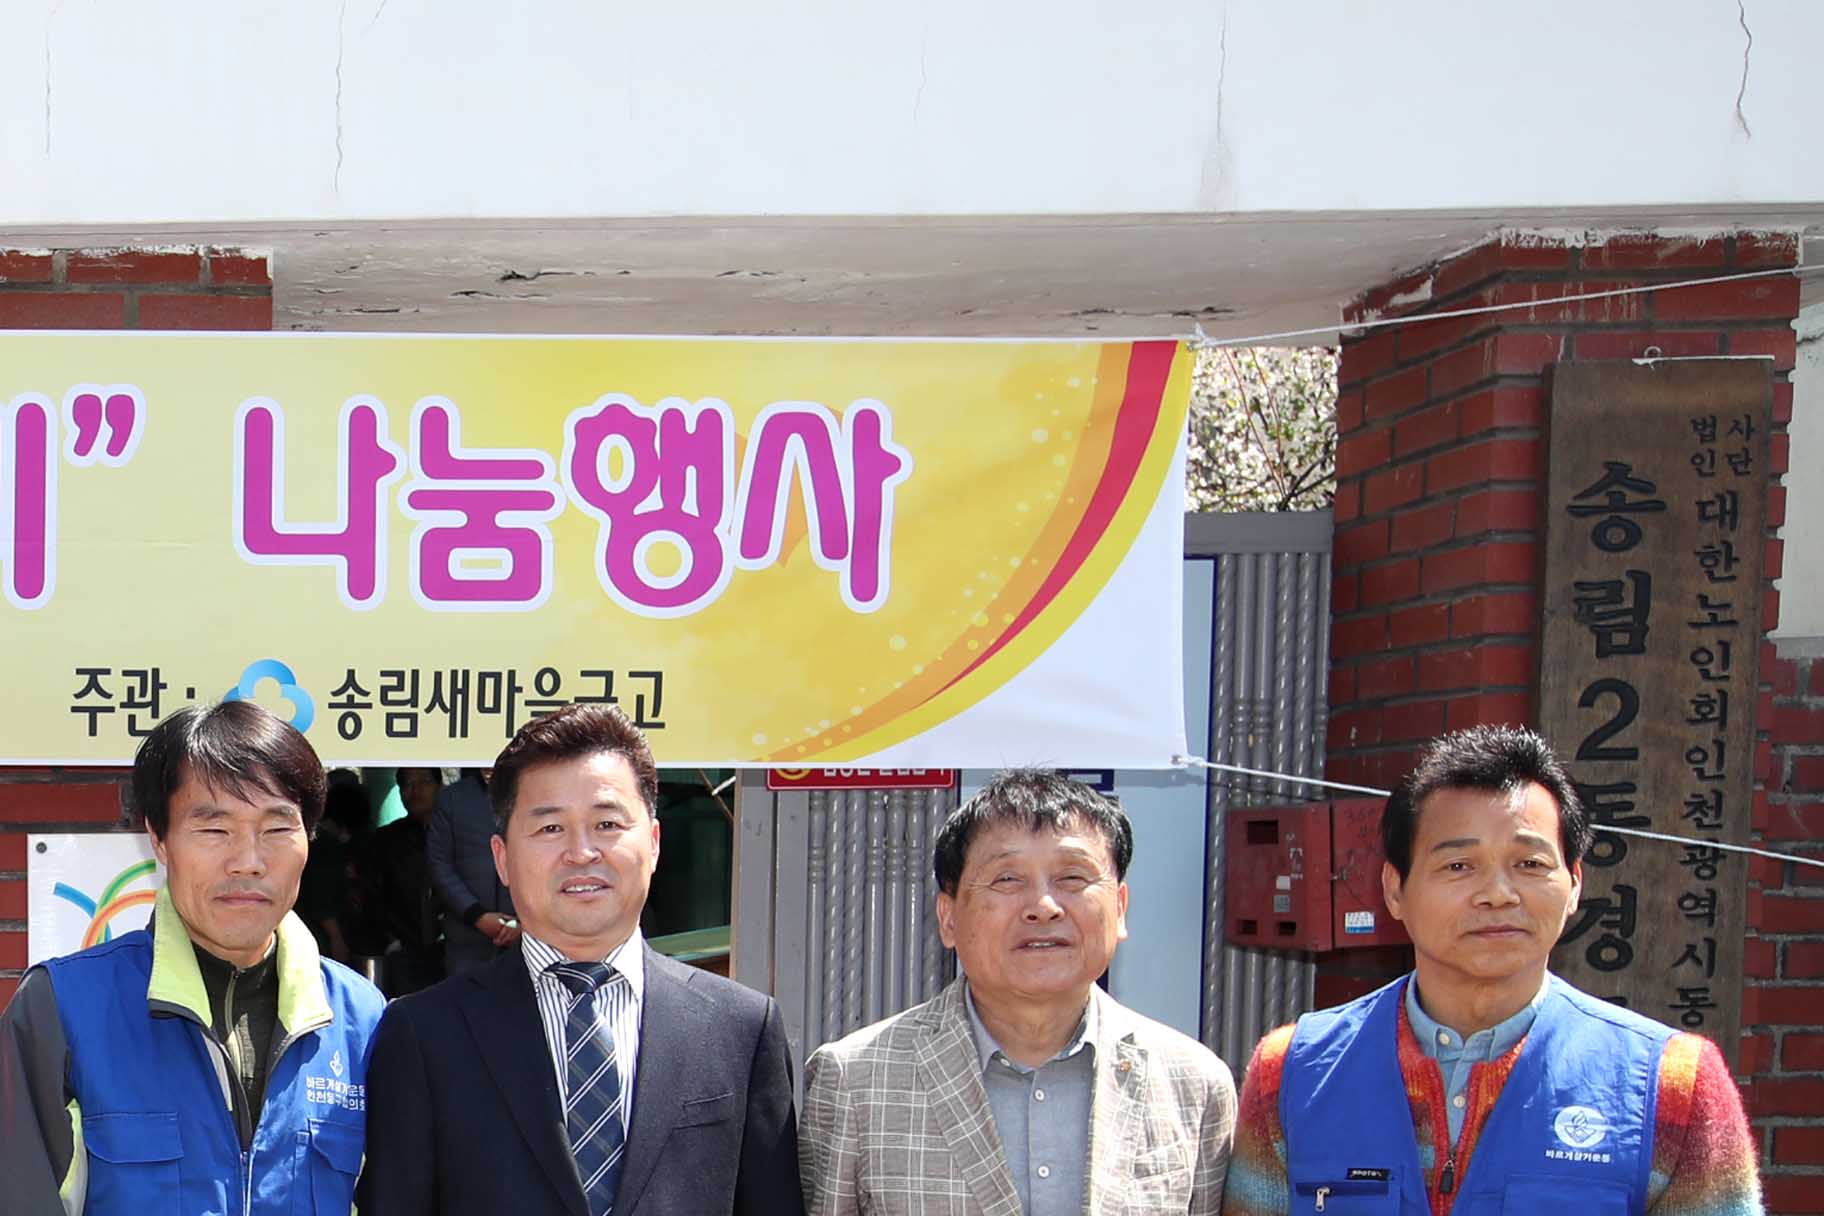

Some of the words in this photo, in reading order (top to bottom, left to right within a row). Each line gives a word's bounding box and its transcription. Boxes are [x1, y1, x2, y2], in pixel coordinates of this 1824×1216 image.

[241, 402, 905, 610] 나눔행사
[70, 667, 167, 737] 주관
[1560, 460, 1666, 1007] 송림2동경
